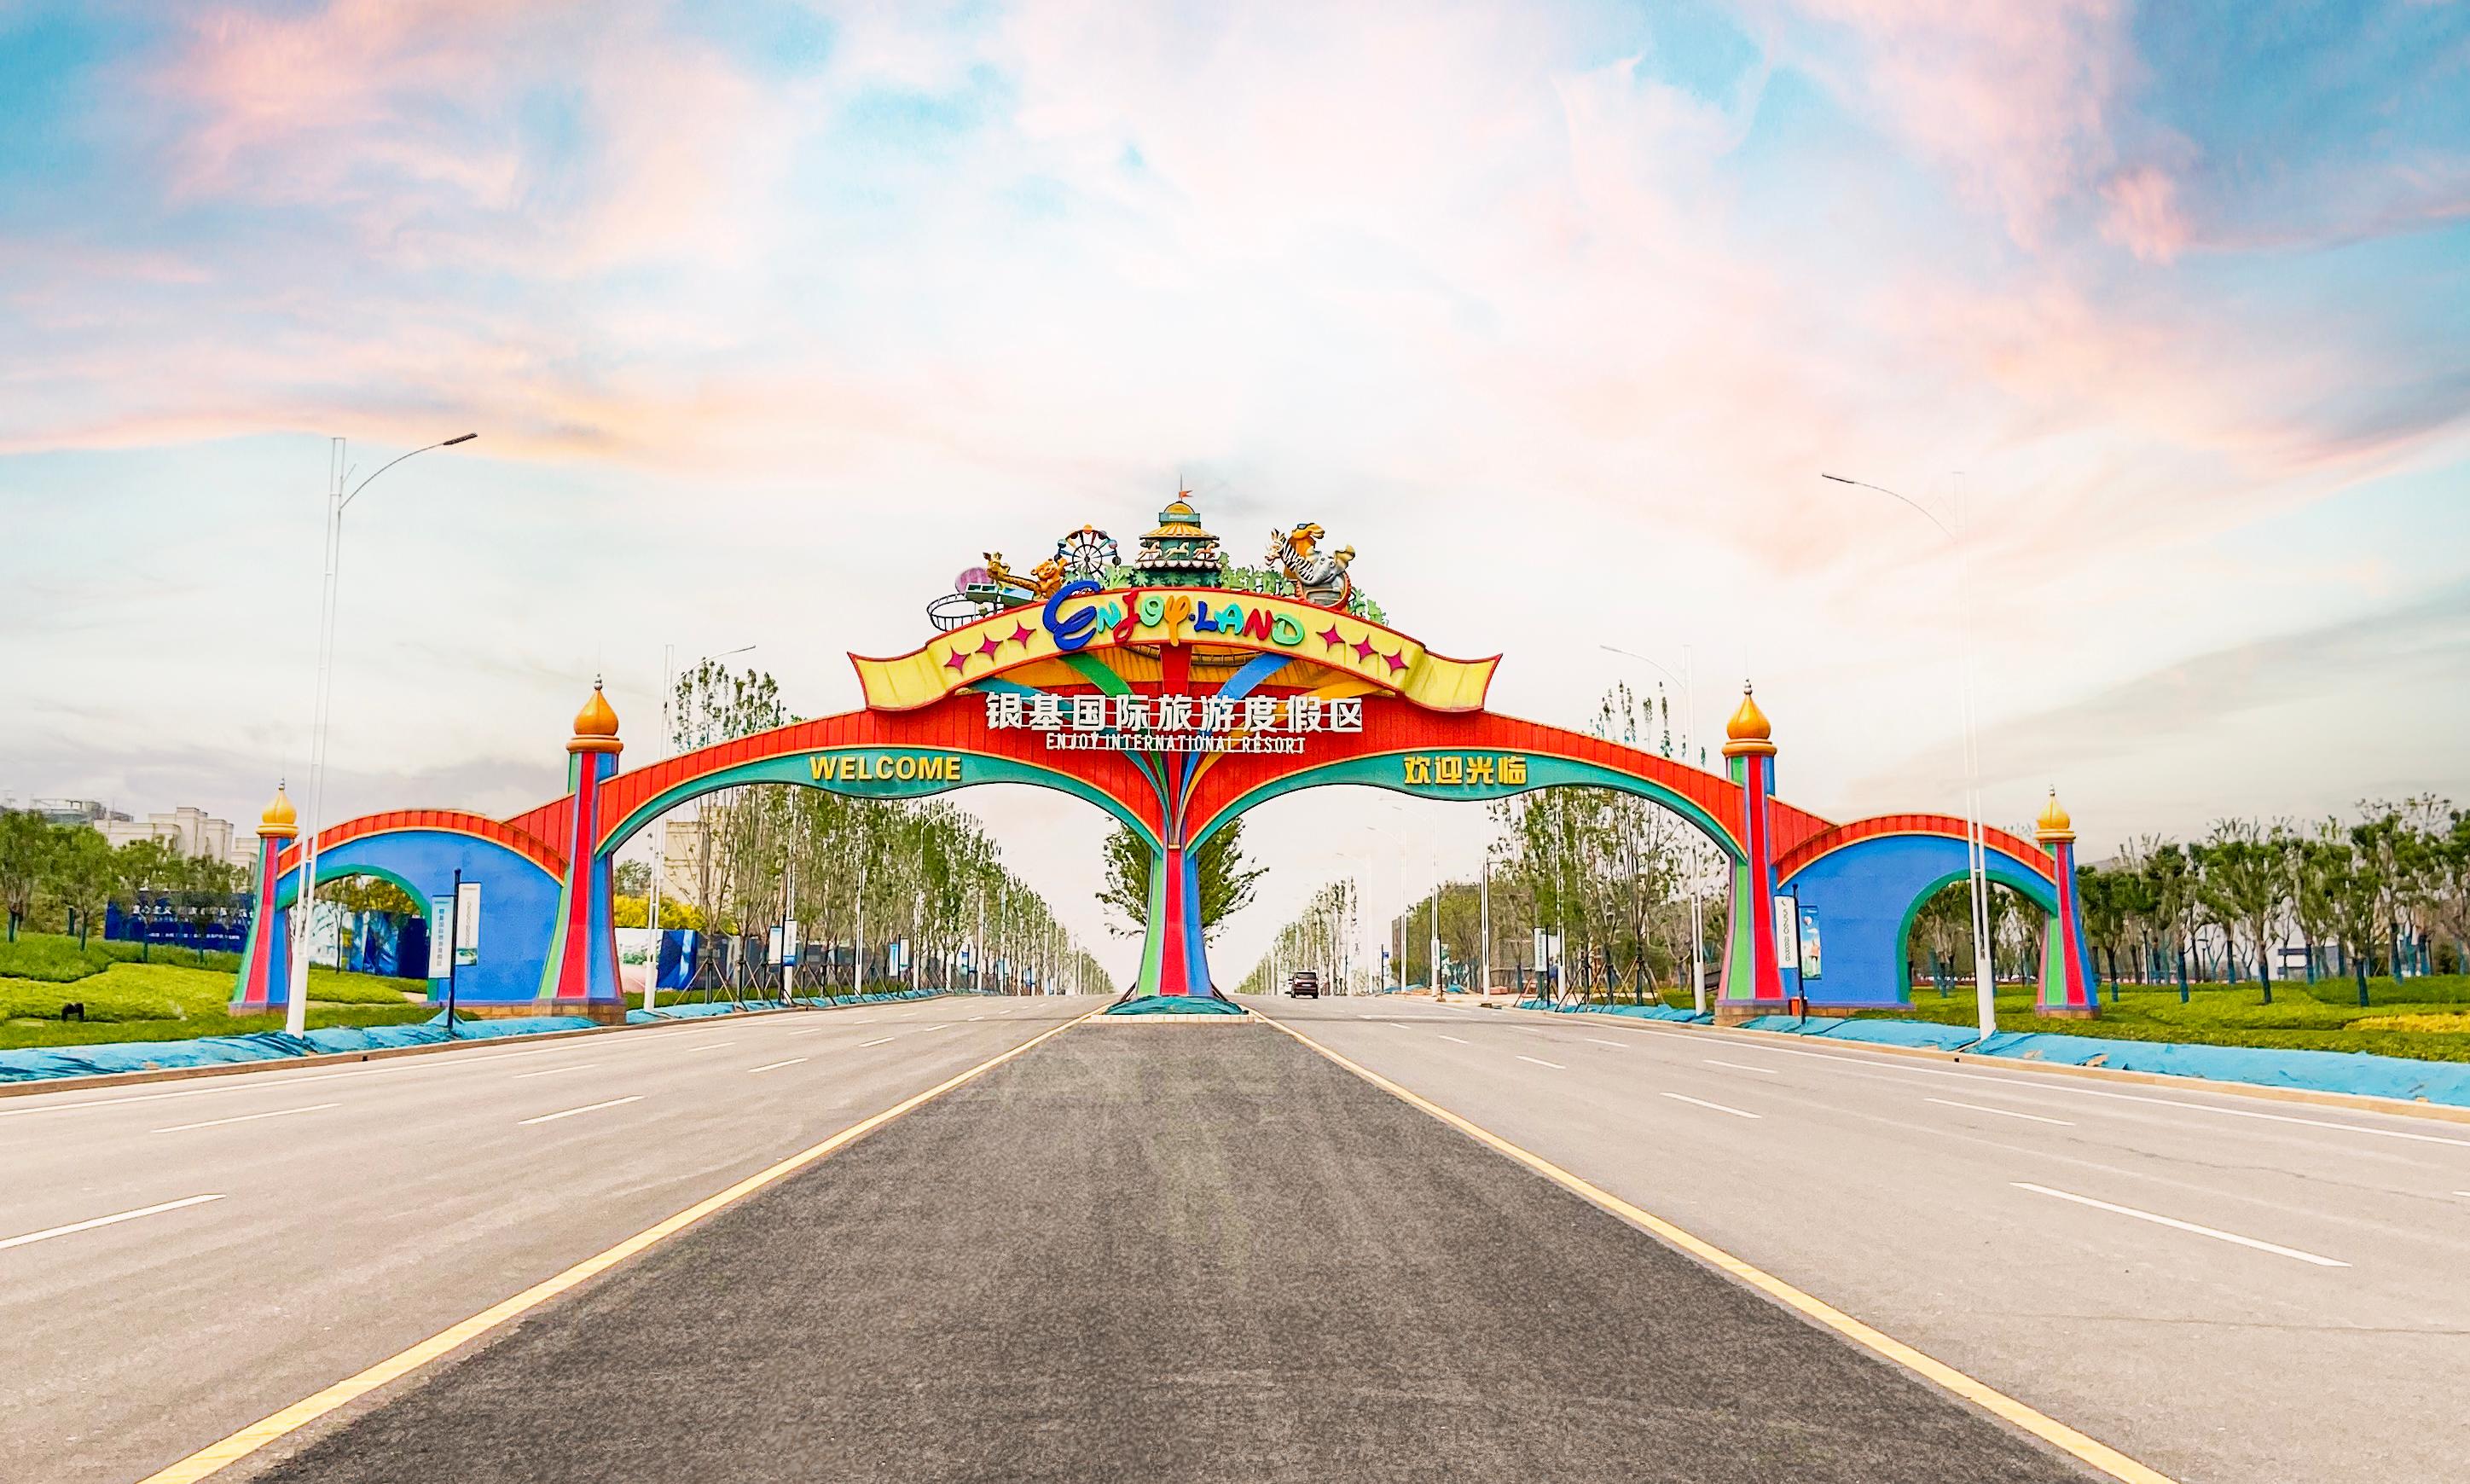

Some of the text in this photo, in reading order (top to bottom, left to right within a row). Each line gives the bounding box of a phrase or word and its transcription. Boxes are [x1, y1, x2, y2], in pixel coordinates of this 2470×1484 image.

[986, 692, 1363, 733] 银基国际旅游度假区
[1046, 732, 1306, 754] ENJOY INTERNATIONAL RESORT
[809, 756, 961, 780] WELCOME
[1403, 756, 1527, 785] 欢迎光临
